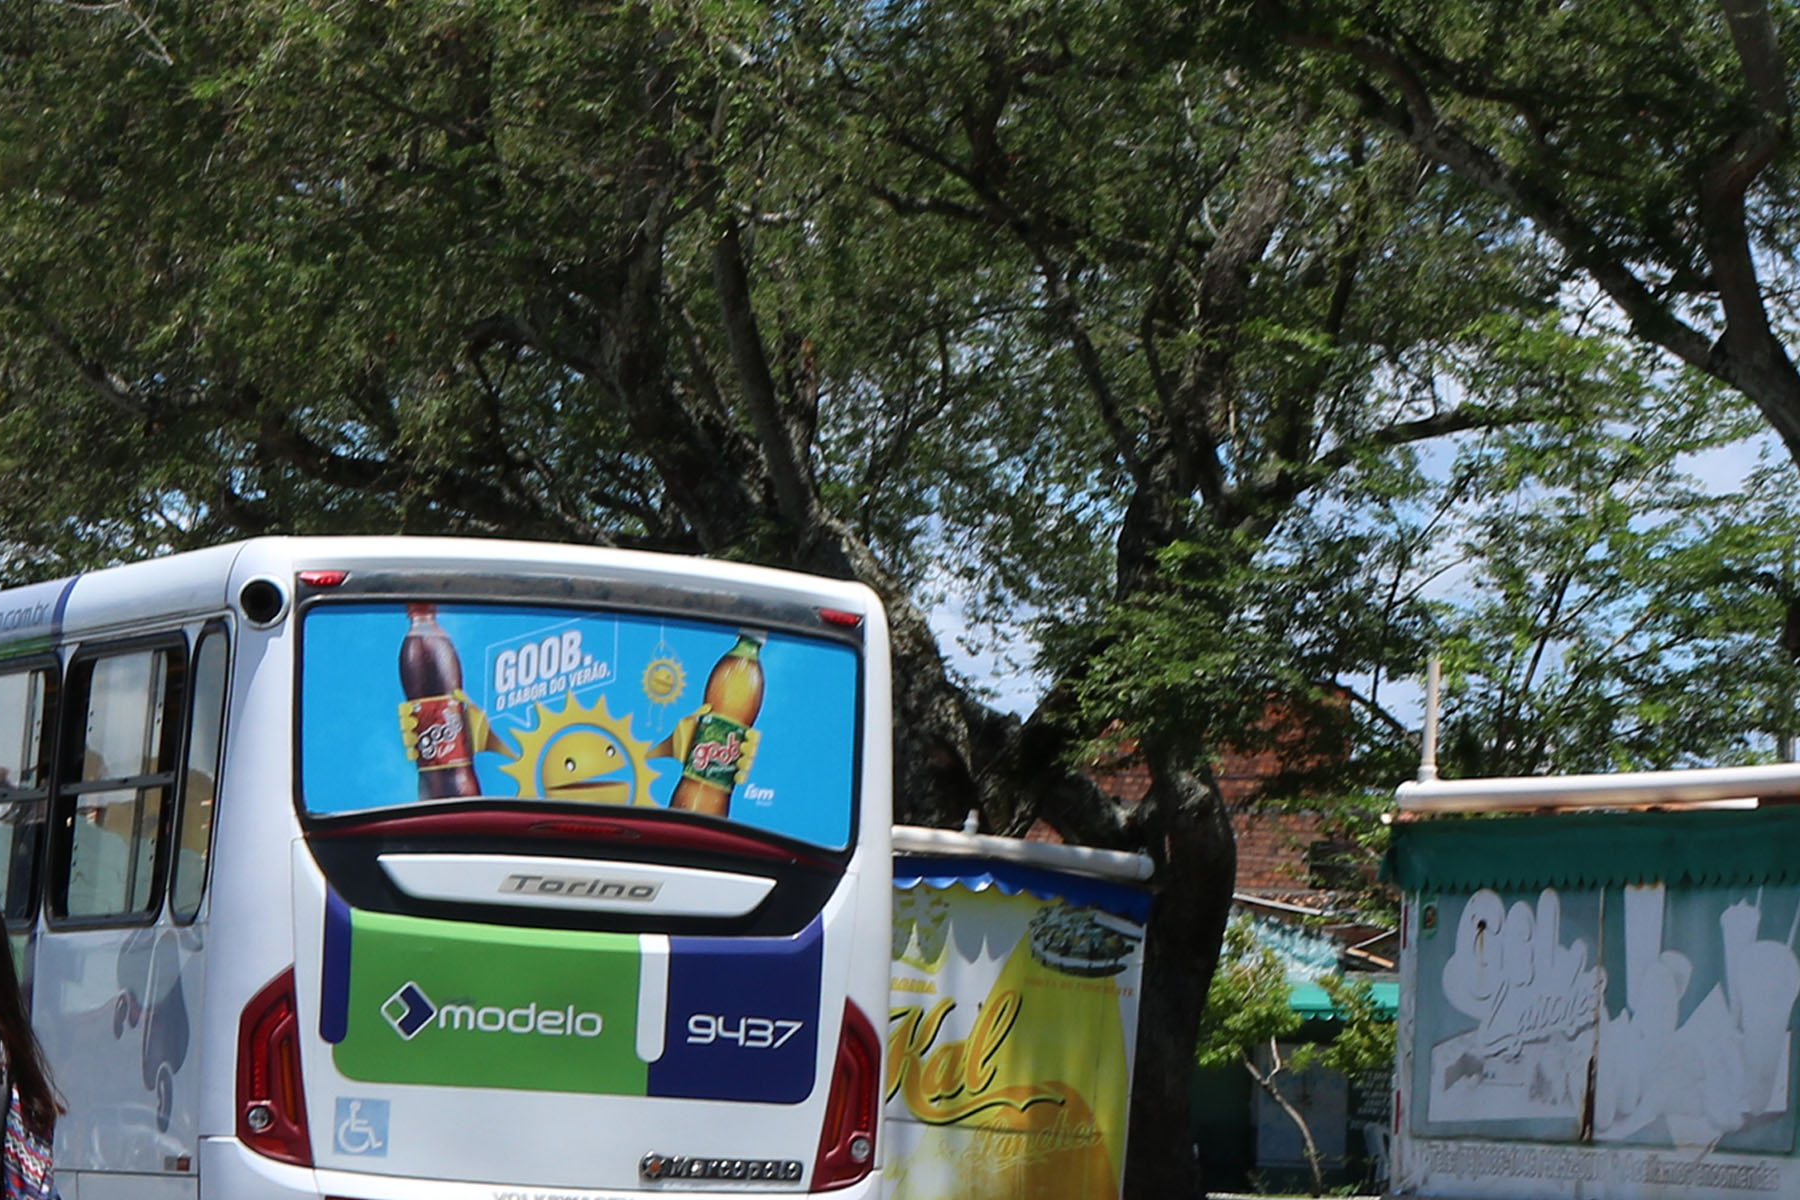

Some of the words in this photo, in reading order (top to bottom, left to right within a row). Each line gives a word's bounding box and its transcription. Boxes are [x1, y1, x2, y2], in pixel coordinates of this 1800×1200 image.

[495, 630, 592, 694] GOOB.
[496, 694, 506, 711] O
[507, 680, 547, 708] SABOR
[549, 674, 566, 694] DO
[509, 875, 654, 899] Torino
[437, 1003, 603, 1038] modelo
[686, 1014, 803, 1050] 9437
[888, 989, 1065, 1126] Kal
[669, 1156, 801, 1180] Marcopolo
